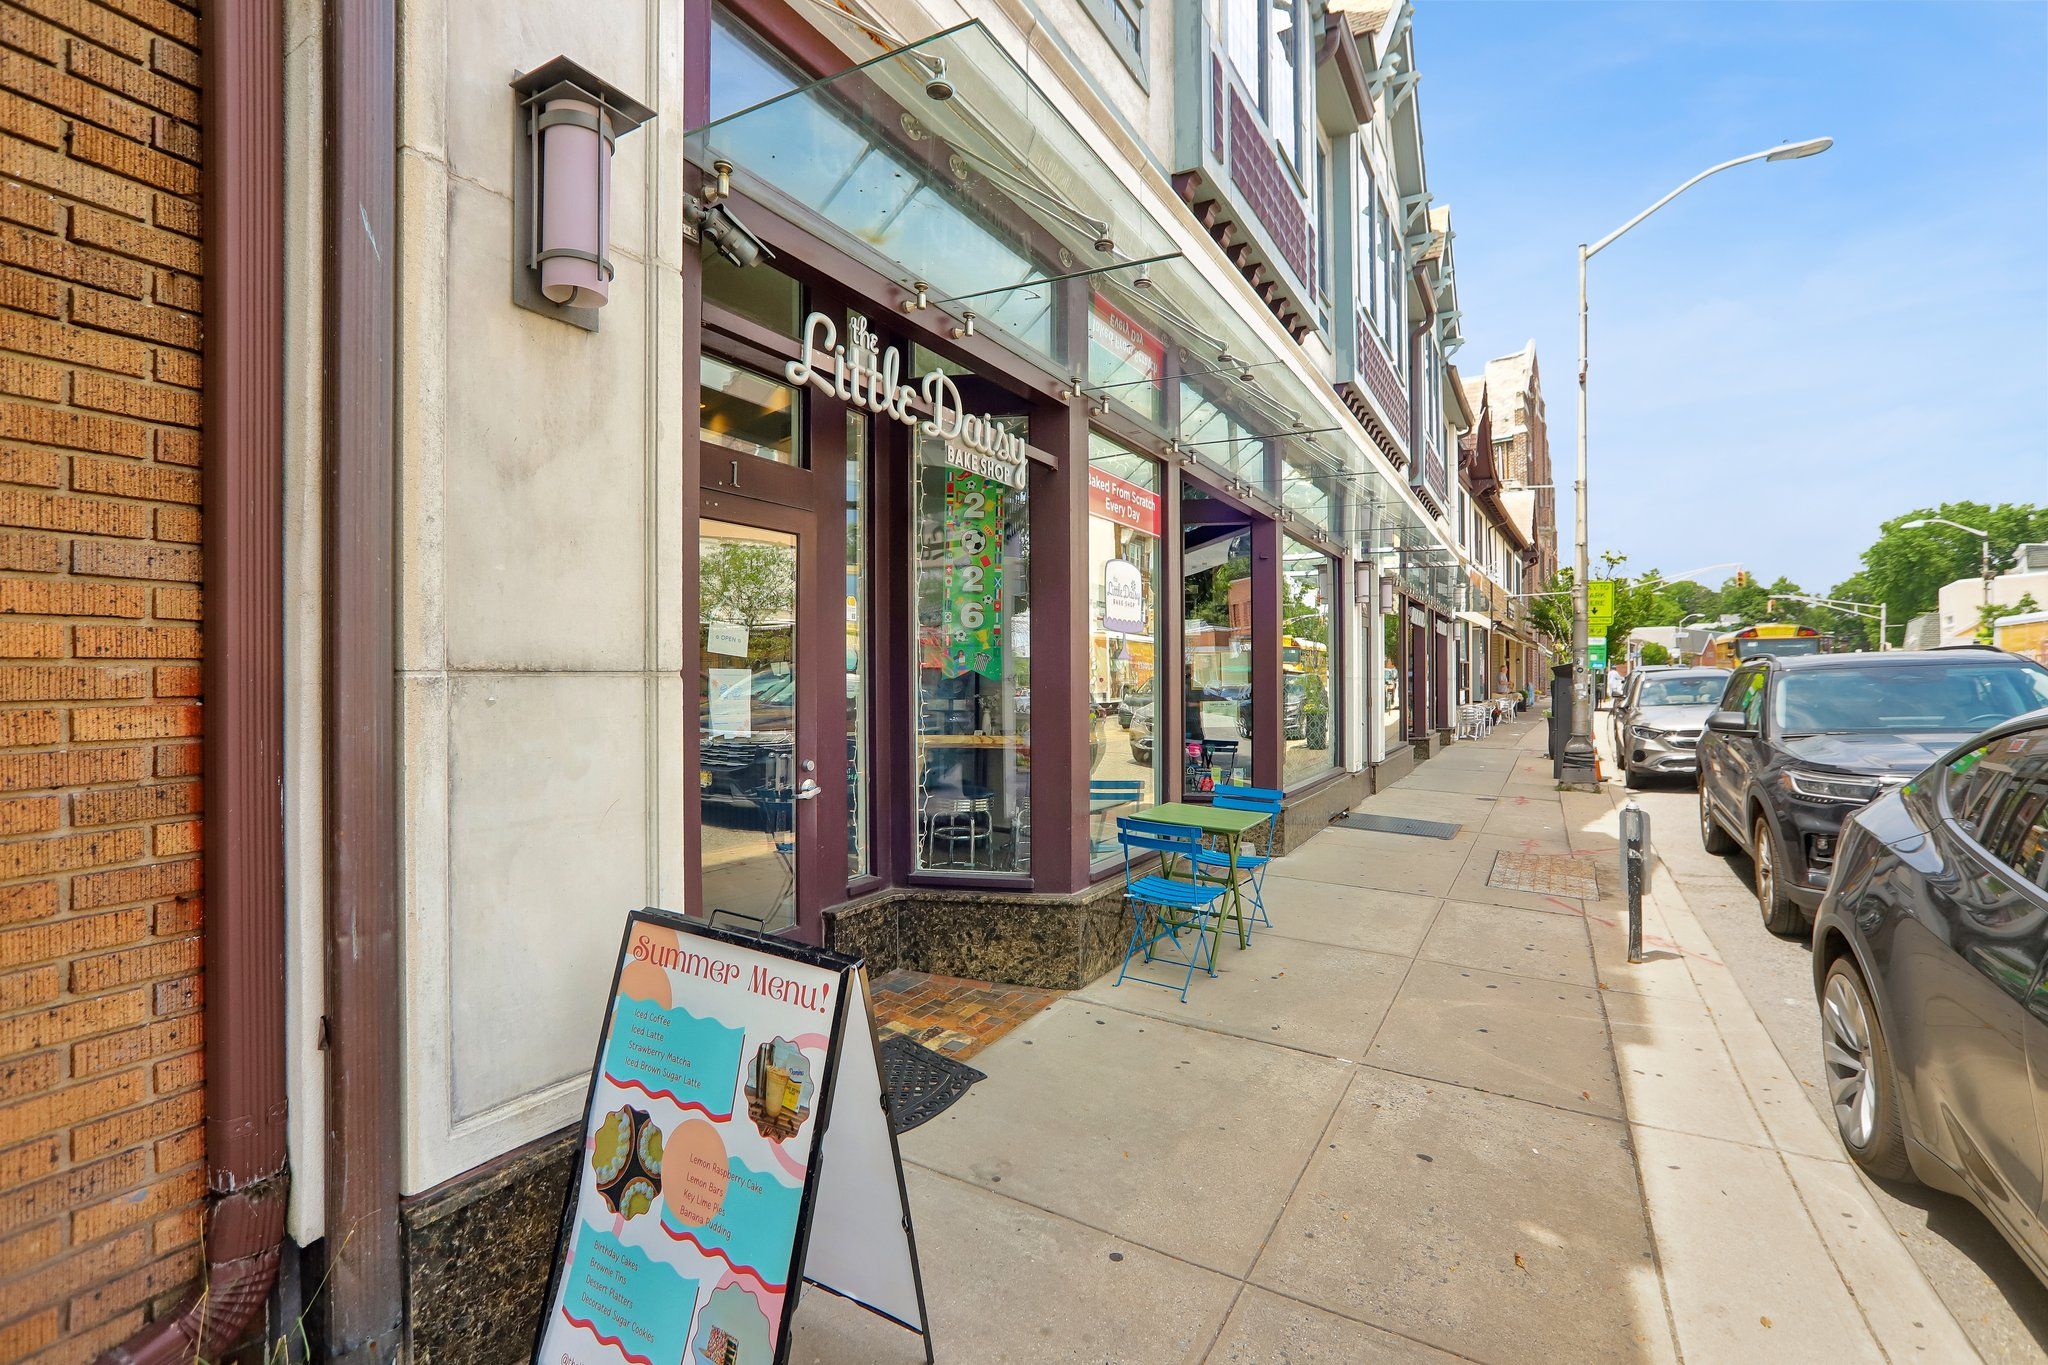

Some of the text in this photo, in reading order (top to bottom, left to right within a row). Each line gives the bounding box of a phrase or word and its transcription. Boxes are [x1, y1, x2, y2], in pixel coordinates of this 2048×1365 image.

[850, 316, 880, 355] the
[785, 312, 1029, 490] Little Daisy
[946, 444, 1010, 482] BAKE SHOP
[1105, 497, 1140, 523] Every Day
[1111, 483, 1131, 501] From
[1131, 491, 1156, 512] Scratch
[721, 635, 737, 643] OPEN
[632, 935, 830, 1014] Summer Menu!
[631, 1024, 665, 1041] Iced Latte
[634, 1008, 671, 1027] Iced Coffee
[628, 1040, 691, 1068] Strawberry Matcha
[625, 1056, 702, 1089] Iced Brown Sugar Latte
[686, 1172, 724, 1197] Lemon Bars
[689, 1152, 763, 1194] Lemon Raspberry Cake
[683, 1187, 726, 1217] Key Lime Pies
[680, 1205, 732, 1241] Banana Pudding
[590, 1257, 627, 1285] Brownie Tins
[594, 1240, 639, 1272] Birthday Cakes
[585, 1274, 633, 1310] Dessert Platters
[581, 1292, 655, 1344] Decorated Sugar Cookies
